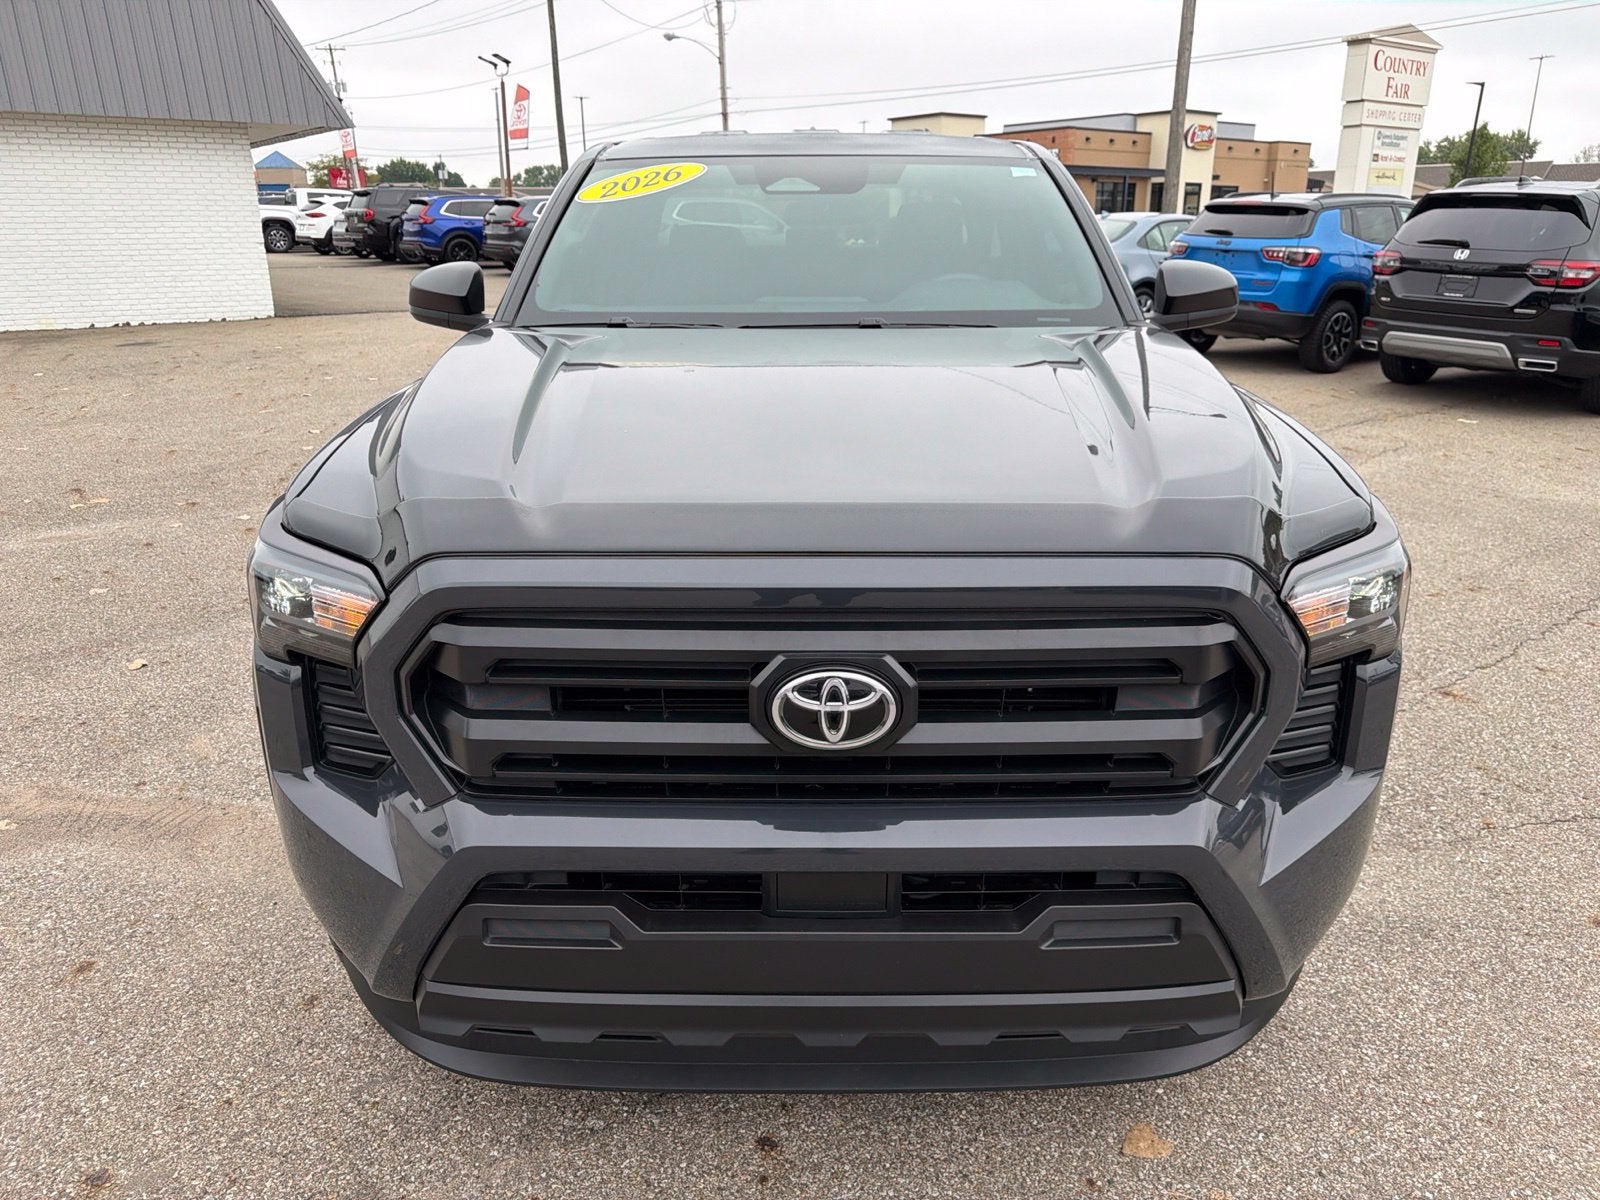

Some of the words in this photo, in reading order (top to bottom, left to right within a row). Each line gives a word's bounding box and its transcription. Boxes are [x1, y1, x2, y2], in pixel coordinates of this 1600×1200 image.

[1374, 49, 1429, 77] COUNTRY
[1385, 76, 1410, 99] FAIR
[1366, 108, 1396, 121] SHOPPING
[1399, 111, 1422, 123] CENTER
[600, 165, 684, 199] 2026
